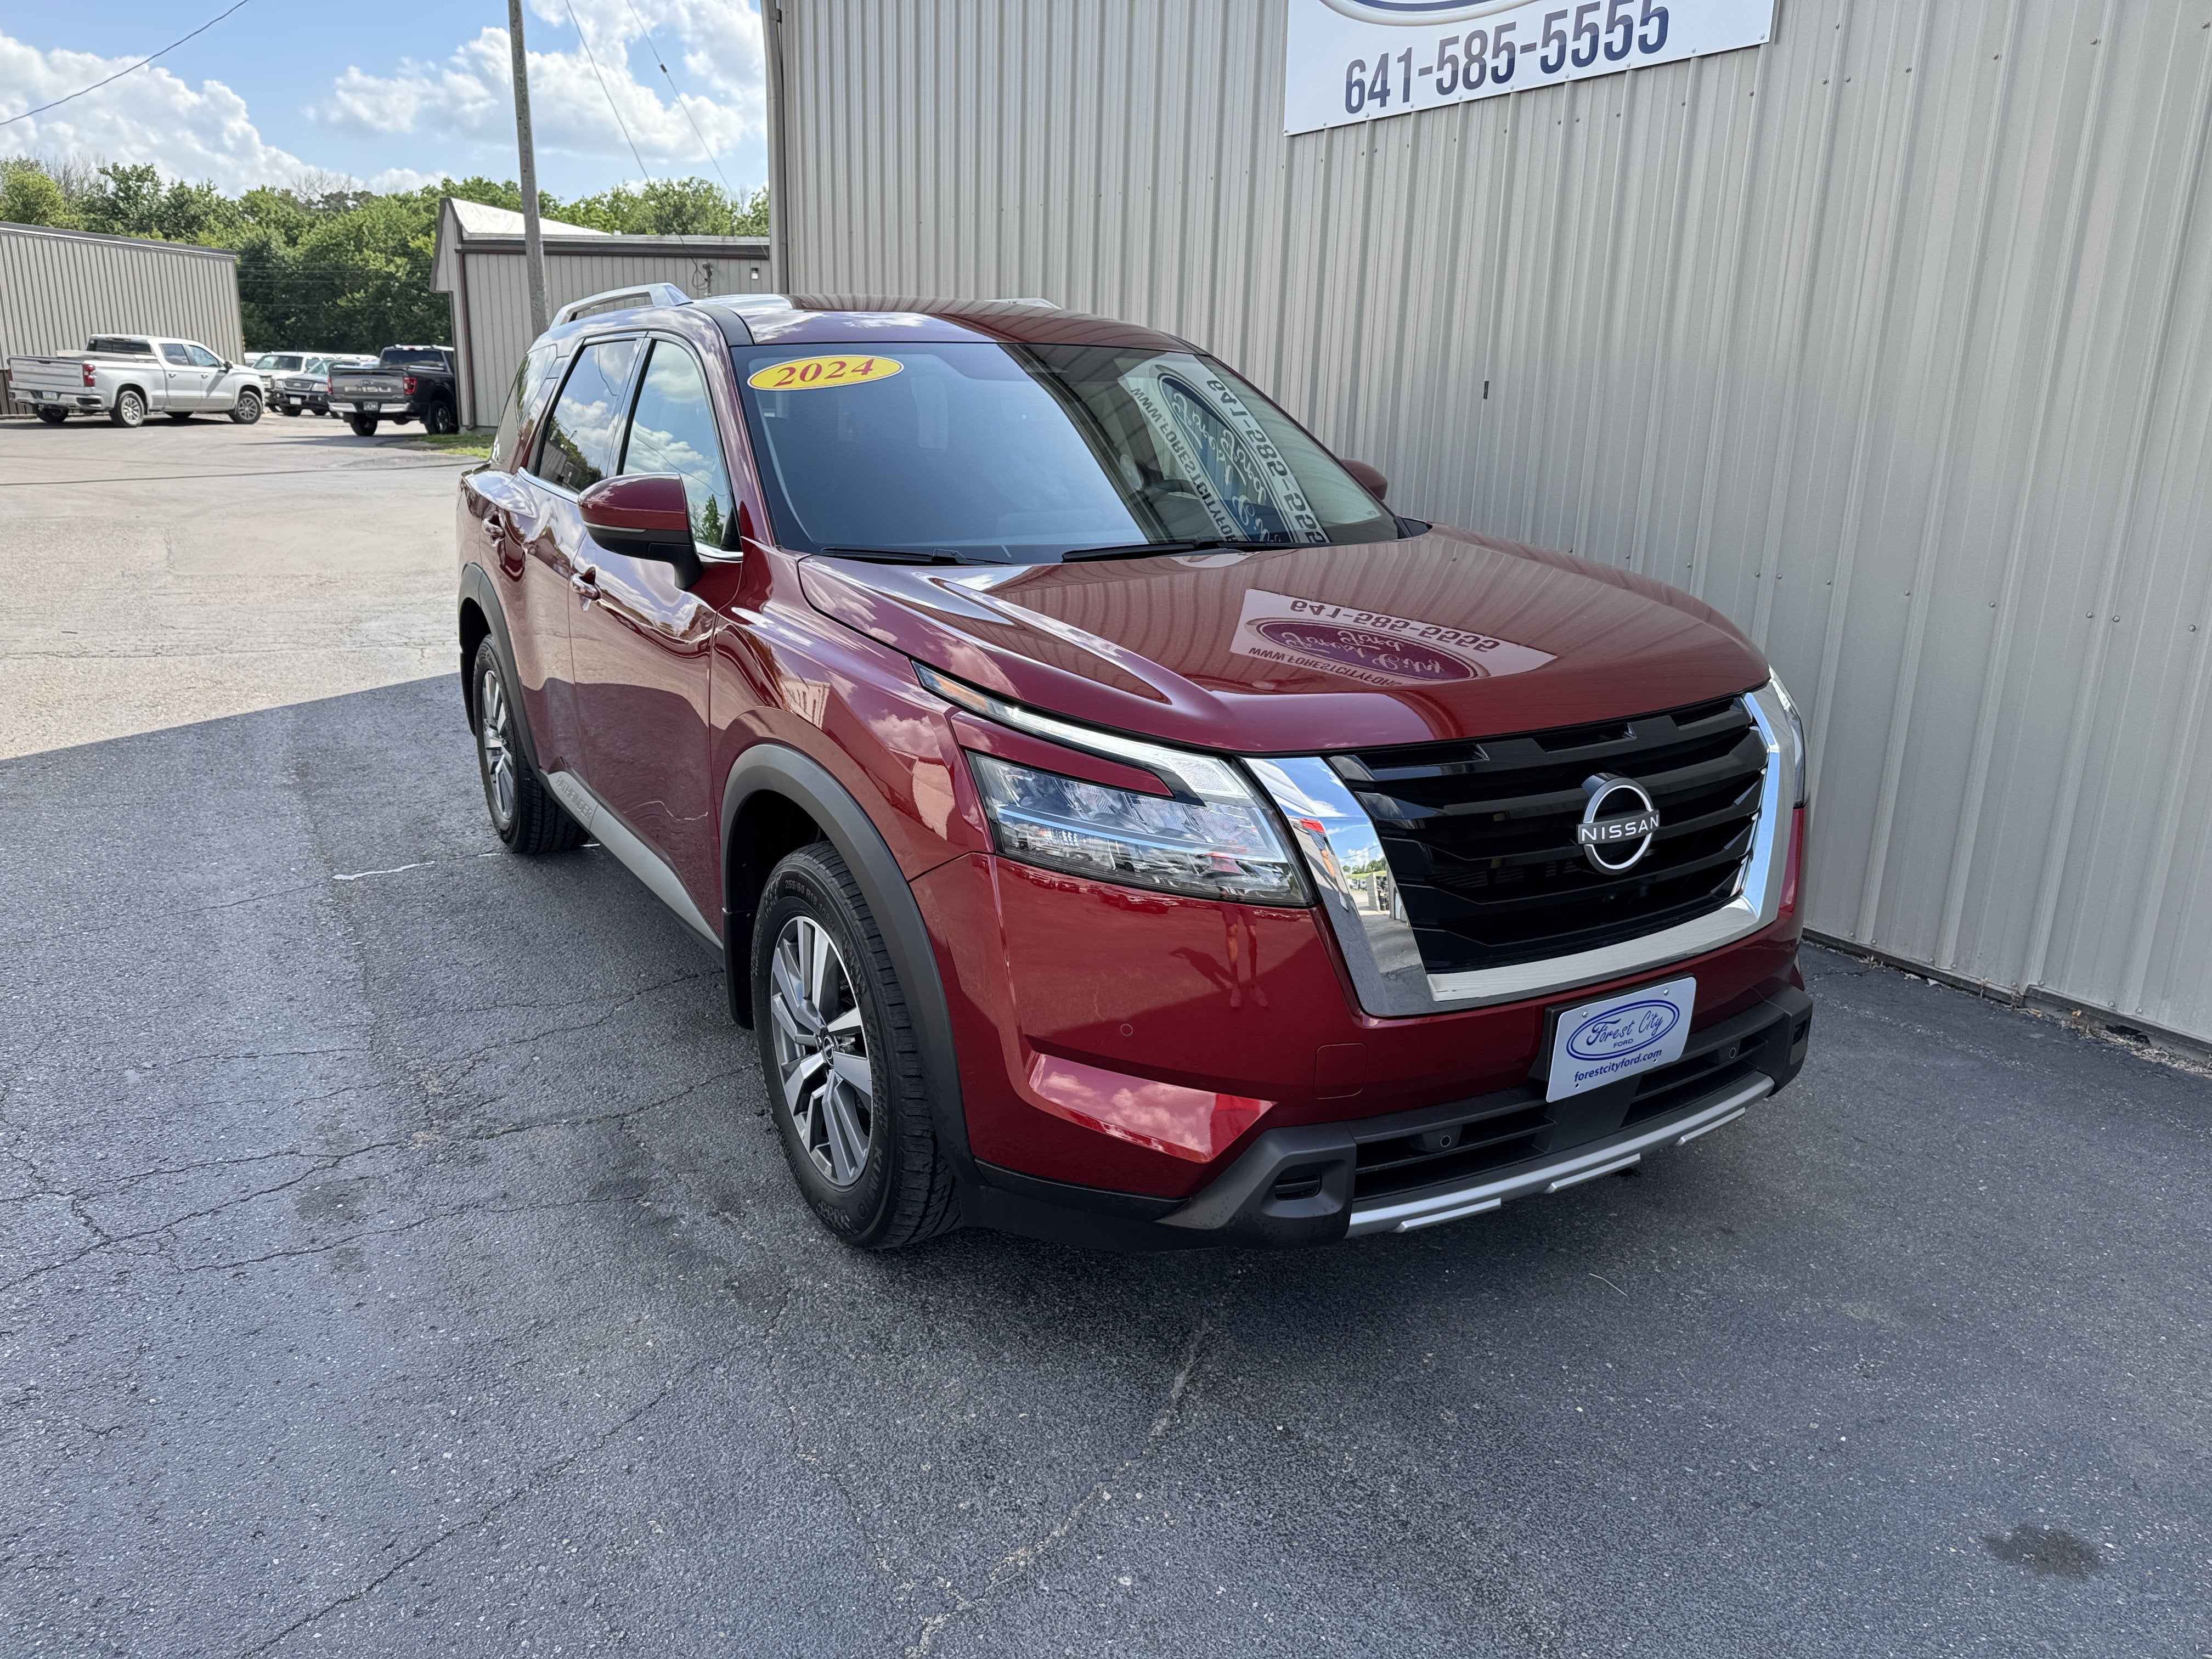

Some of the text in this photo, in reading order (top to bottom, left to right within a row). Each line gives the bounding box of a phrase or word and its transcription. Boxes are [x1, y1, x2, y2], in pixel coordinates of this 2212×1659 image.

[1345, 0, 1669, 114] 641-585-5555
[773, 358, 875, 387] 2024
[555, 775, 593, 821] PATHFINDER
[1581, 814, 1659, 842] NISSAN
[785, 879, 805, 895] 255/60
[805, 888, 817, 906] R18
[1586, 1010, 1663, 1046] Forest City
[1613, 1038, 1633, 1048] FORD
[1574, 1049, 1662, 1082] forestcityford.com
